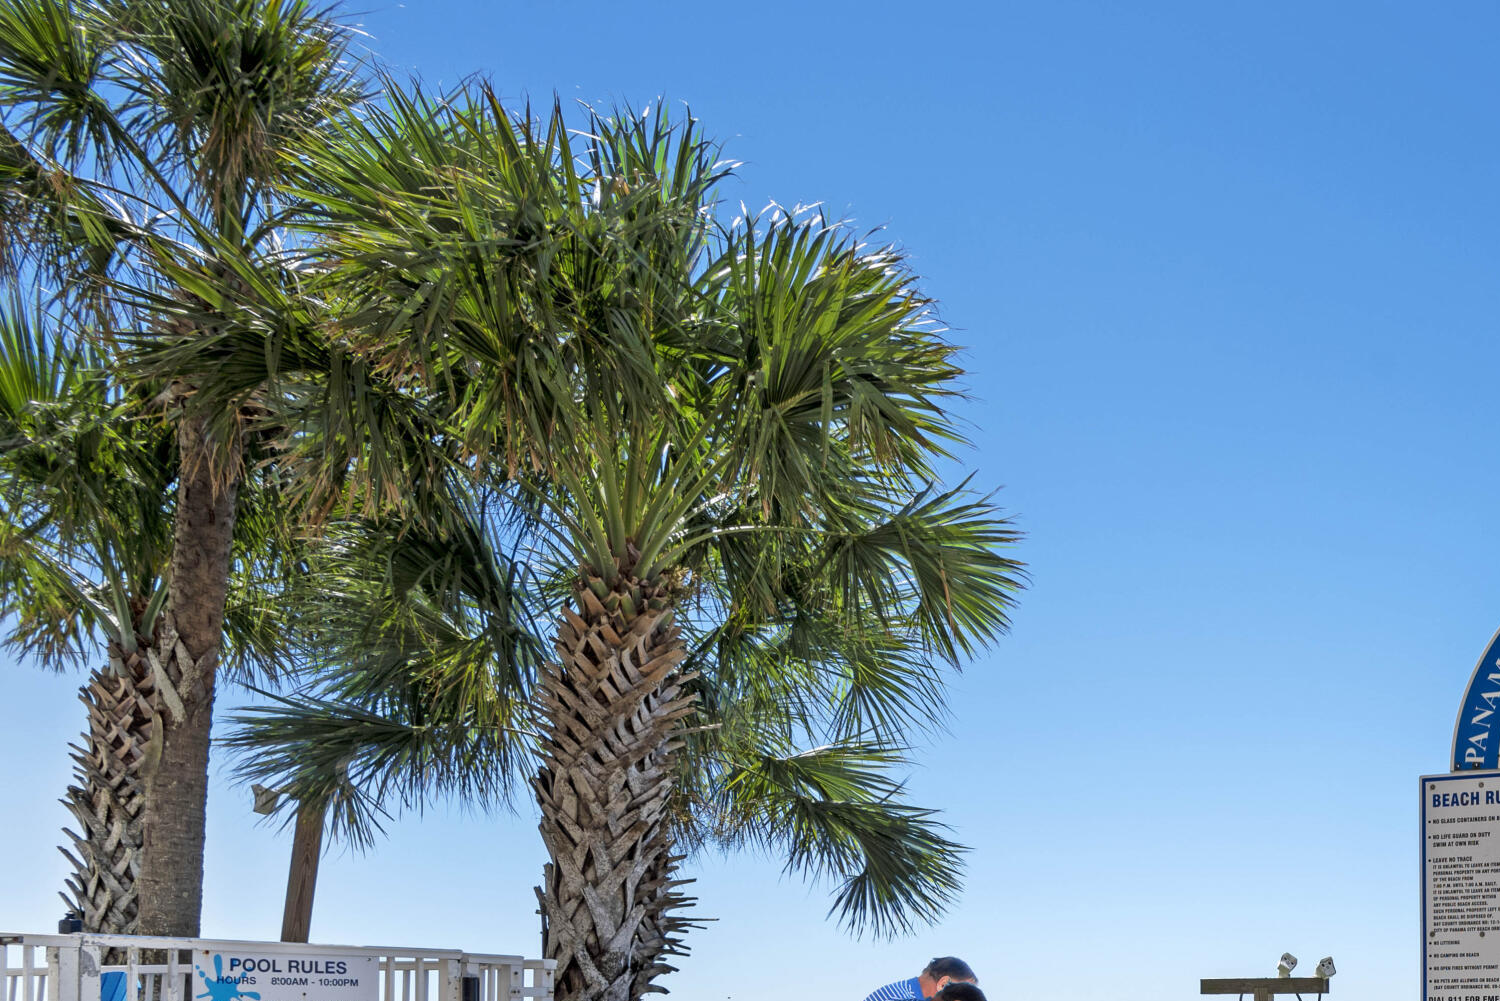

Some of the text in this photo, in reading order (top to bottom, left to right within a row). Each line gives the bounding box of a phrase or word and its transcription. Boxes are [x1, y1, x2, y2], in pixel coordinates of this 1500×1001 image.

[1432, 792, 1480, 807] BEACH
[230, 958, 347, 974] POOL RULES
[217, 976, 257, 985] HOURS
